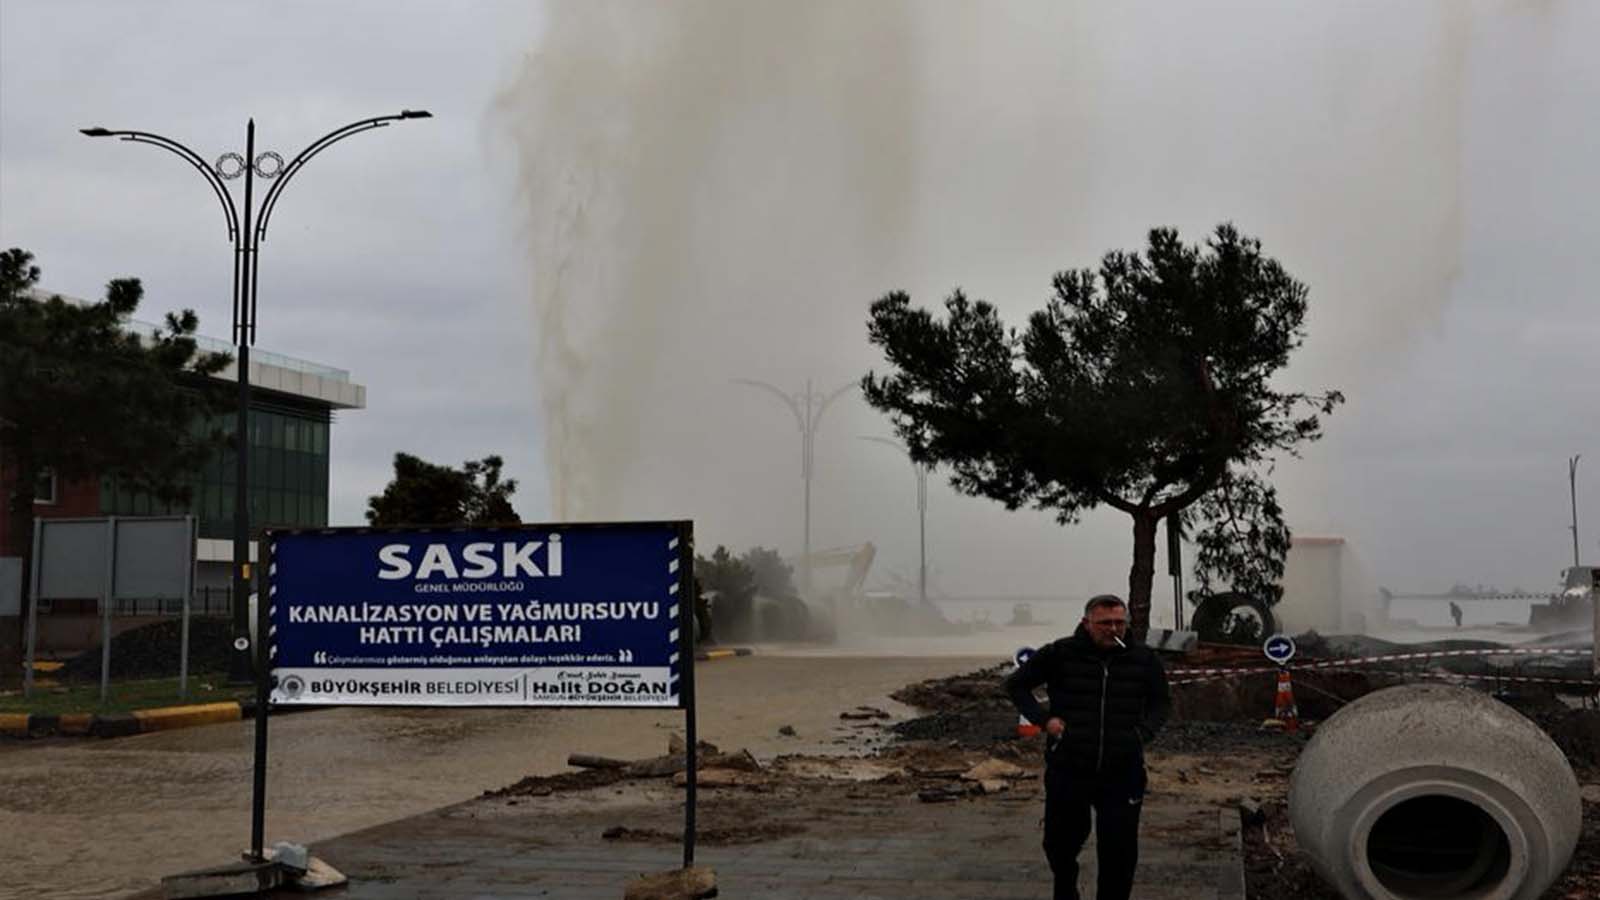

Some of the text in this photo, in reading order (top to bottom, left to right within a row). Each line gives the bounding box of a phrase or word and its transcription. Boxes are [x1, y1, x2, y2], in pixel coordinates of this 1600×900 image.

[378, 533, 562, 580] SASKİ
[414, 581, 524, 593] GENEL MÜDÜRLÜĞÜ
[289, 600, 659, 622] KANALİZASYON VE YAĞMURSUYU
[360, 625, 580, 648] HATTI ÇALIŞMALARI
[311, 678, 519, 696] BÜYÜKŞEHİR BELEDİYESİ
[533, 680, 667, 694] Halit DOĞAN
